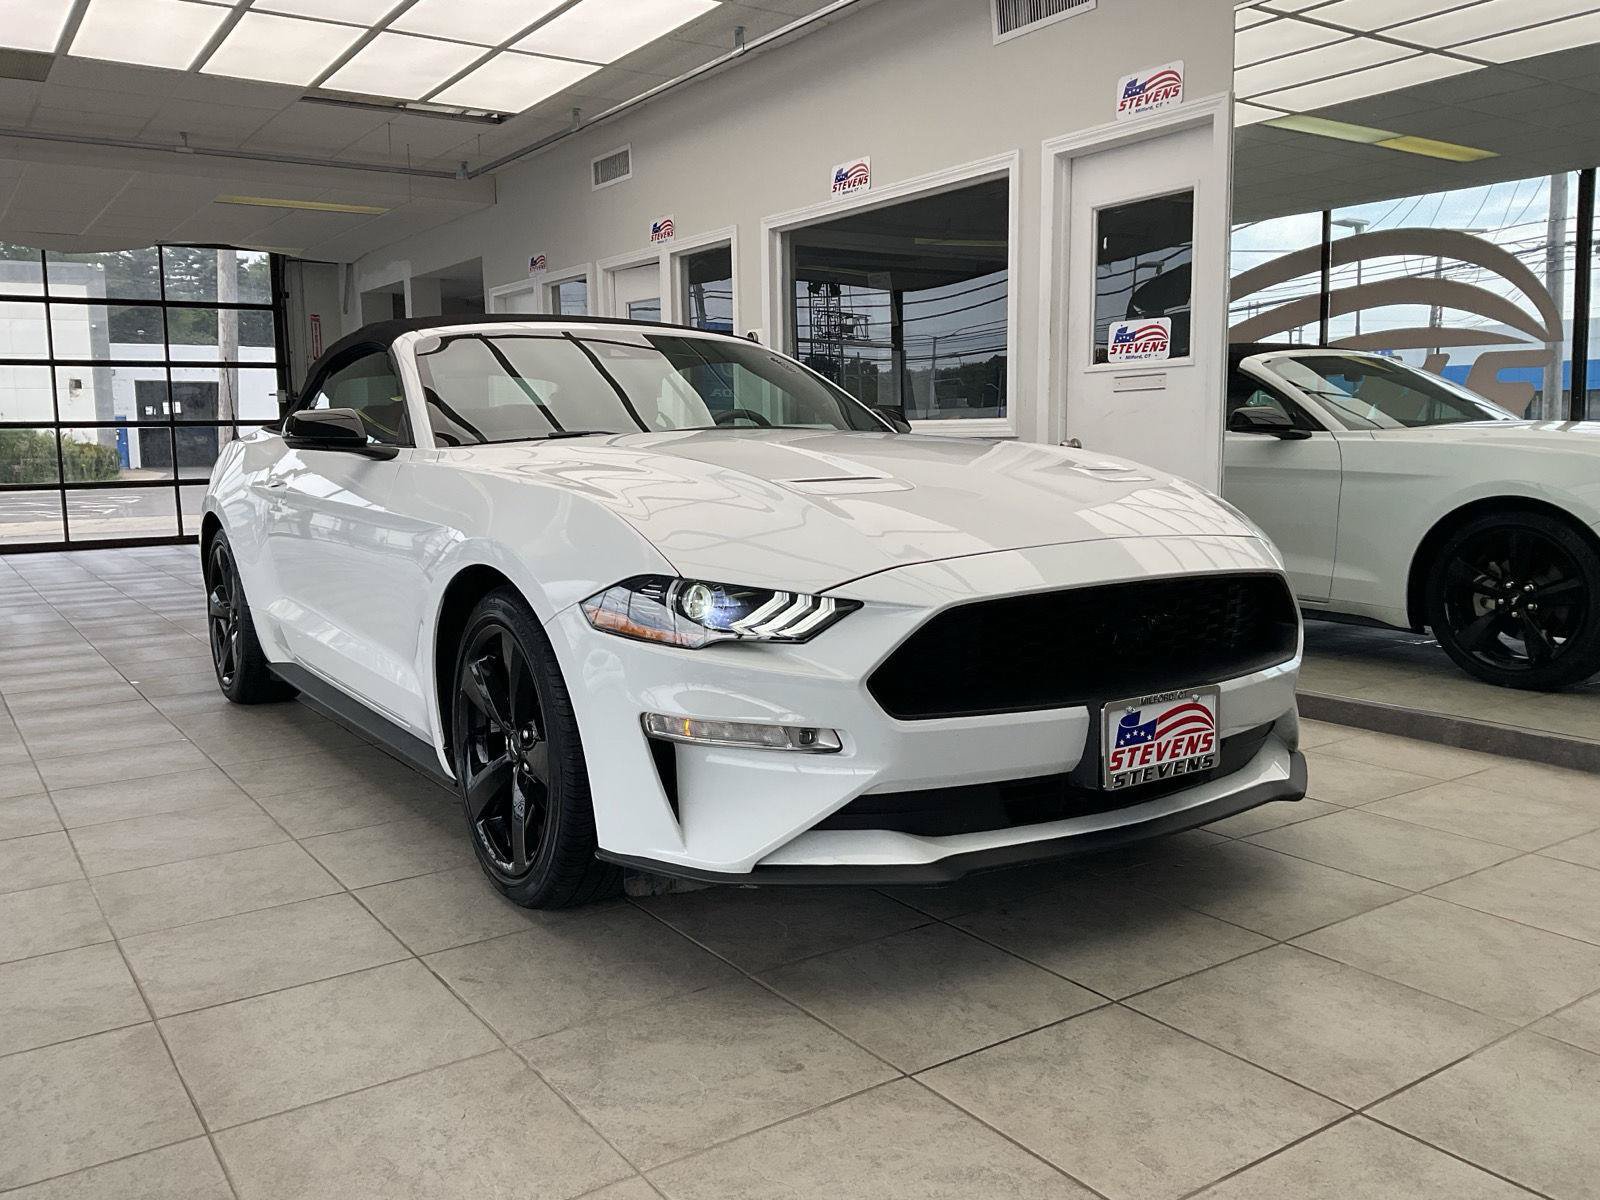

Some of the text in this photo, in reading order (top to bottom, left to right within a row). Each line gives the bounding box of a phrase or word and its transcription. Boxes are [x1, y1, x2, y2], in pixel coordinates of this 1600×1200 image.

[1118, 85, 1181, 112] STEVENS
[832, 175, 869, 193] STEVENS
[650, 230, 674, 242] STEVENS
[1109, 341, 1168, 355] STEVENS
[1109, 732, 1214, 771] STEVENS
[1112, 753, 1215, 789] STEVENS
